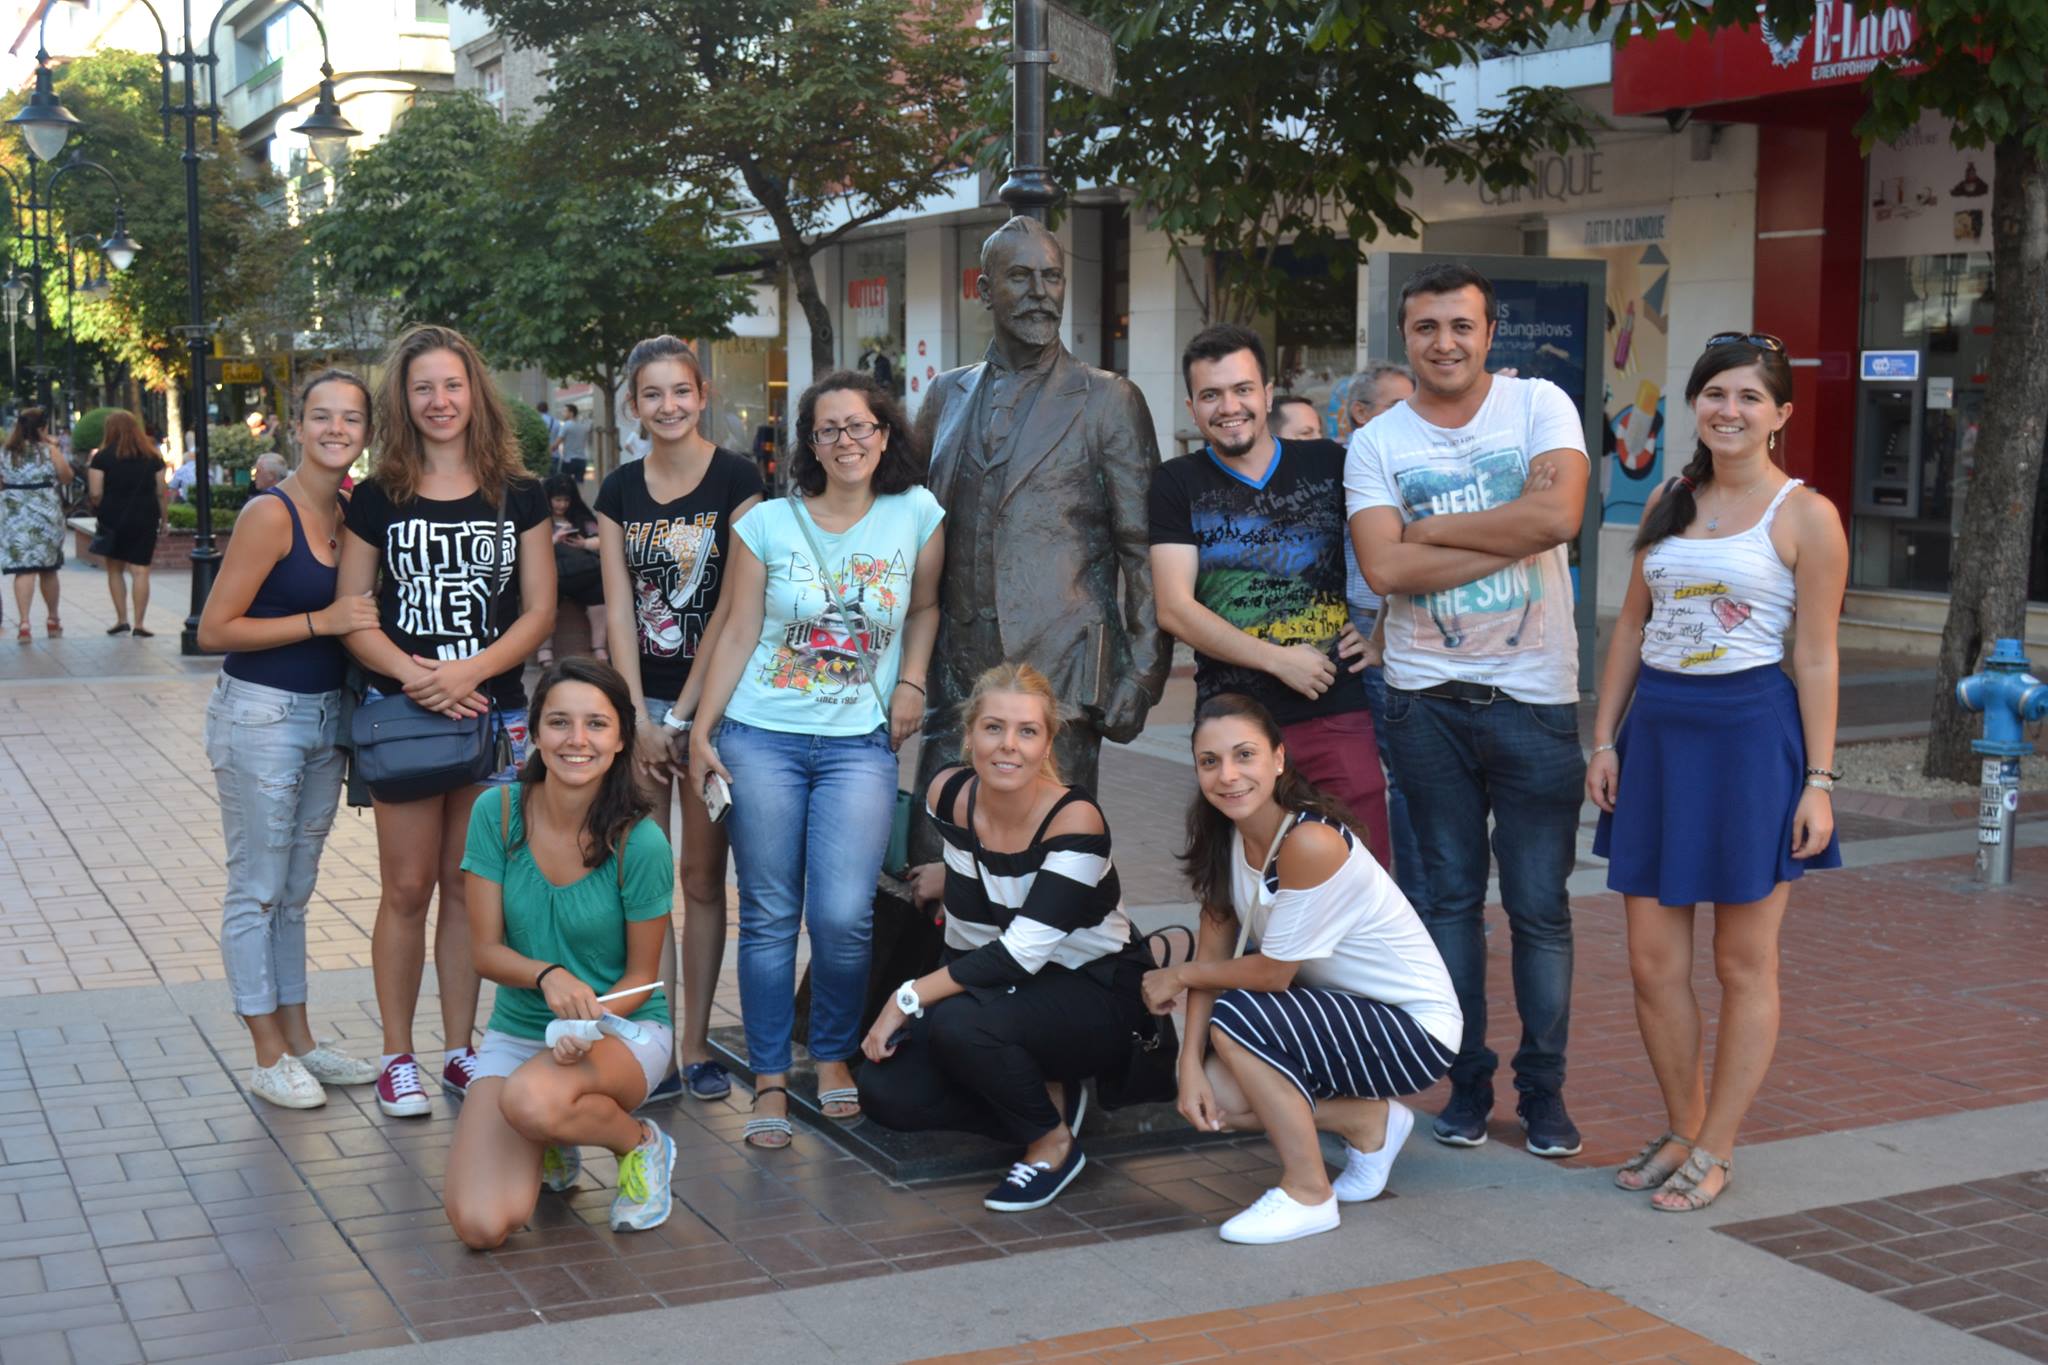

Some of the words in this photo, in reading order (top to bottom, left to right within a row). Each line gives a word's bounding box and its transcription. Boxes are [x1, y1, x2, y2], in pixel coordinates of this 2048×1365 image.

[1479, 151, 1603, 205] CINIQUE
[1498, 320, 1573, 340] Bungalows
[623, 511, 721, 567] WAK
